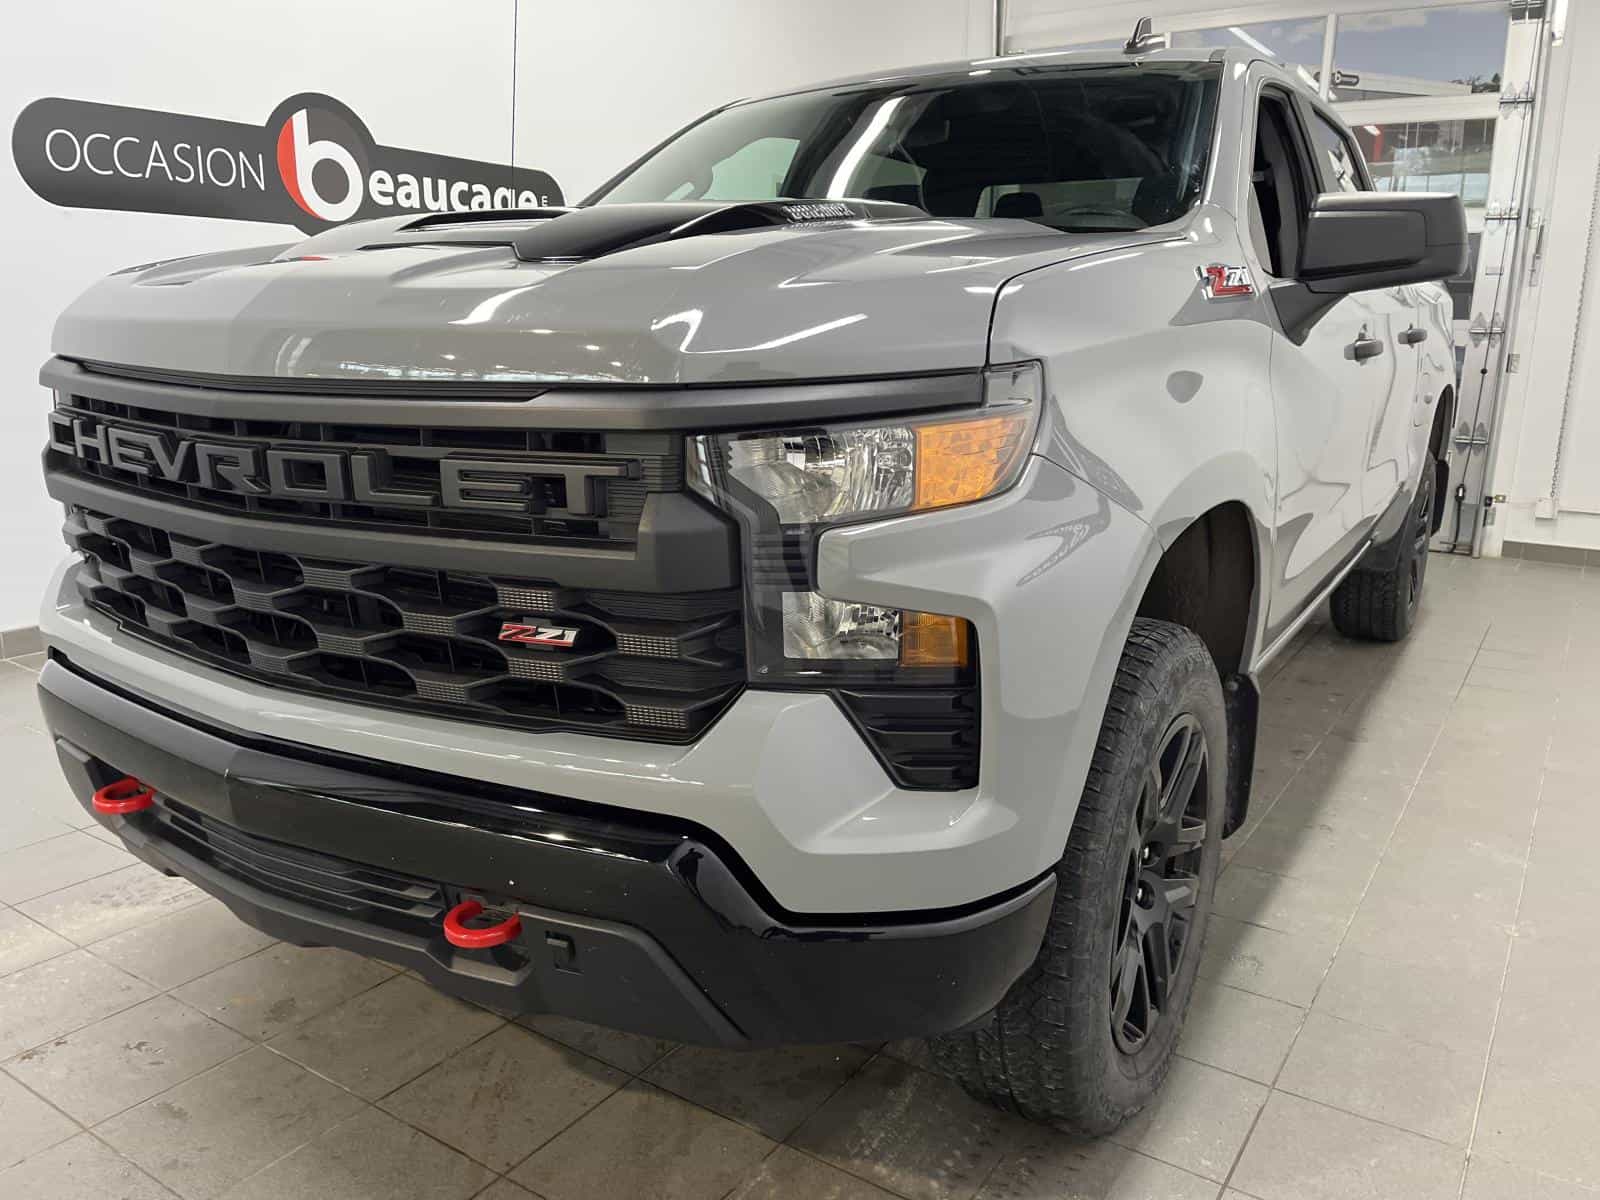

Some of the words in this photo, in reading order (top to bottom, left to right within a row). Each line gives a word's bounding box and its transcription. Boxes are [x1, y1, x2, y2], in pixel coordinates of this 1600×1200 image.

[45, 129, 265, 191] OCCASION
[1201, 265, 1254, 298] Z71
[48, 407, 638, 516] CHEVROLET
[500, 622, 577, 647] Z71
